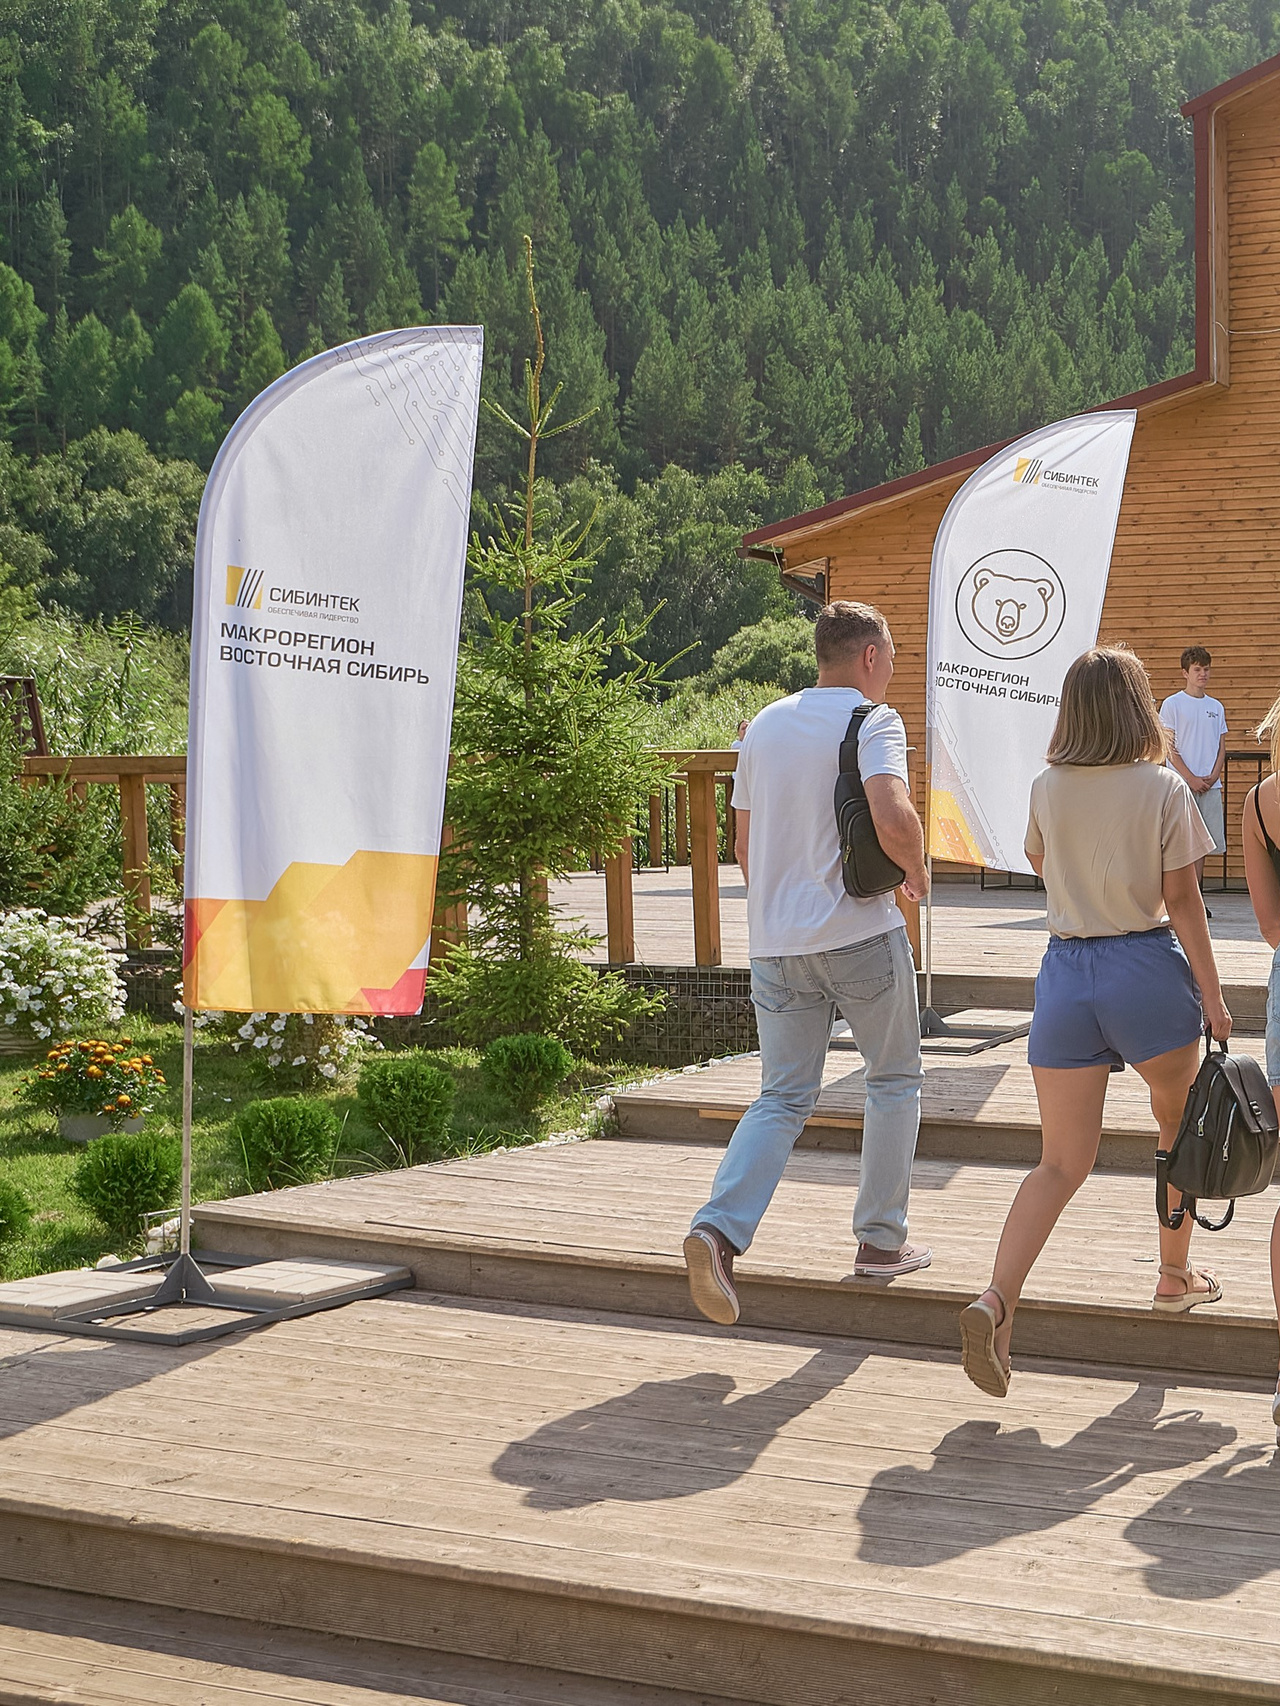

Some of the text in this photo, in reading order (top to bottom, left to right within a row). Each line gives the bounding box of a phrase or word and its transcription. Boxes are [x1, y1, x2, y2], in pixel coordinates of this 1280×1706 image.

[1043, 470, 1100, 488] СИБИНТЕК
[269, 587, 360, 612] СИБИНТЕК
[267, 606, 359, 624] ОБЕСПЕЧИВАЯ ЛИДЕРСТВО
[220, 622, 375, 656] МАКРОРЕГИОН
[220, 645, 430, 685] ВОСТОЧНАЯ СИБИРЬ
